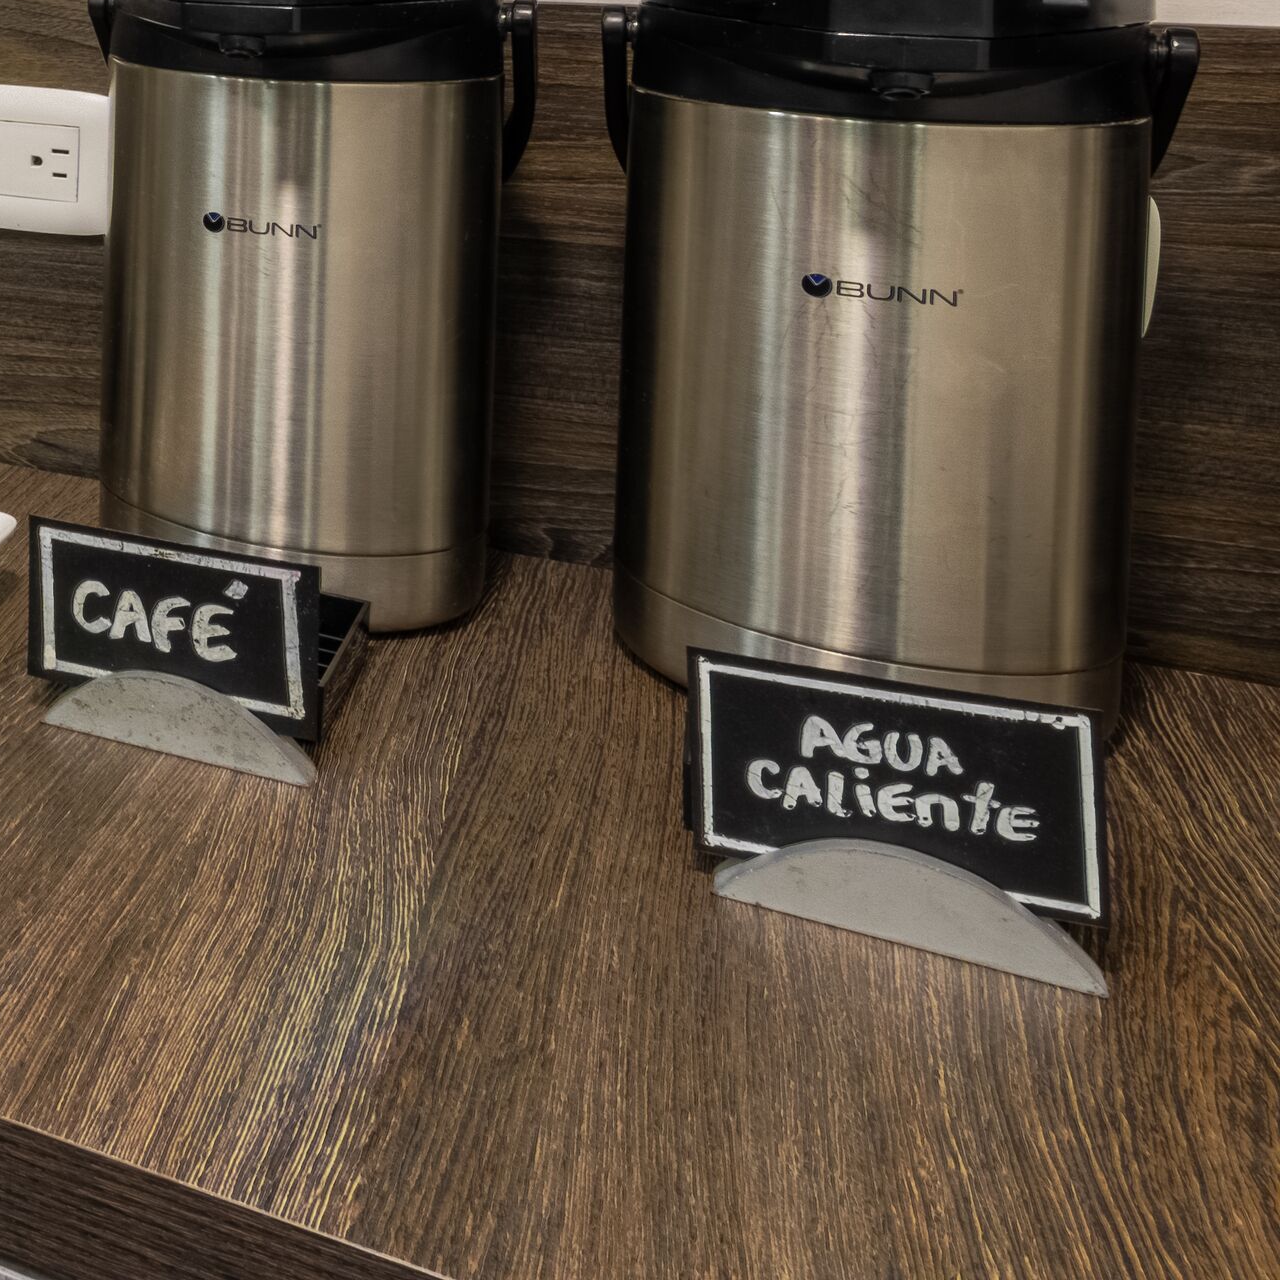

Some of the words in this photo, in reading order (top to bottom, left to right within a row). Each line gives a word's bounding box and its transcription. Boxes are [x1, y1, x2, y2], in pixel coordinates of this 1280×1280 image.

[226, 216, 318, 240] BUNN
[836, 280, 958, 307] BUNN
[72, 578, 249, 663] CAFÉ
[800, 715, 965, 776] AGUA
